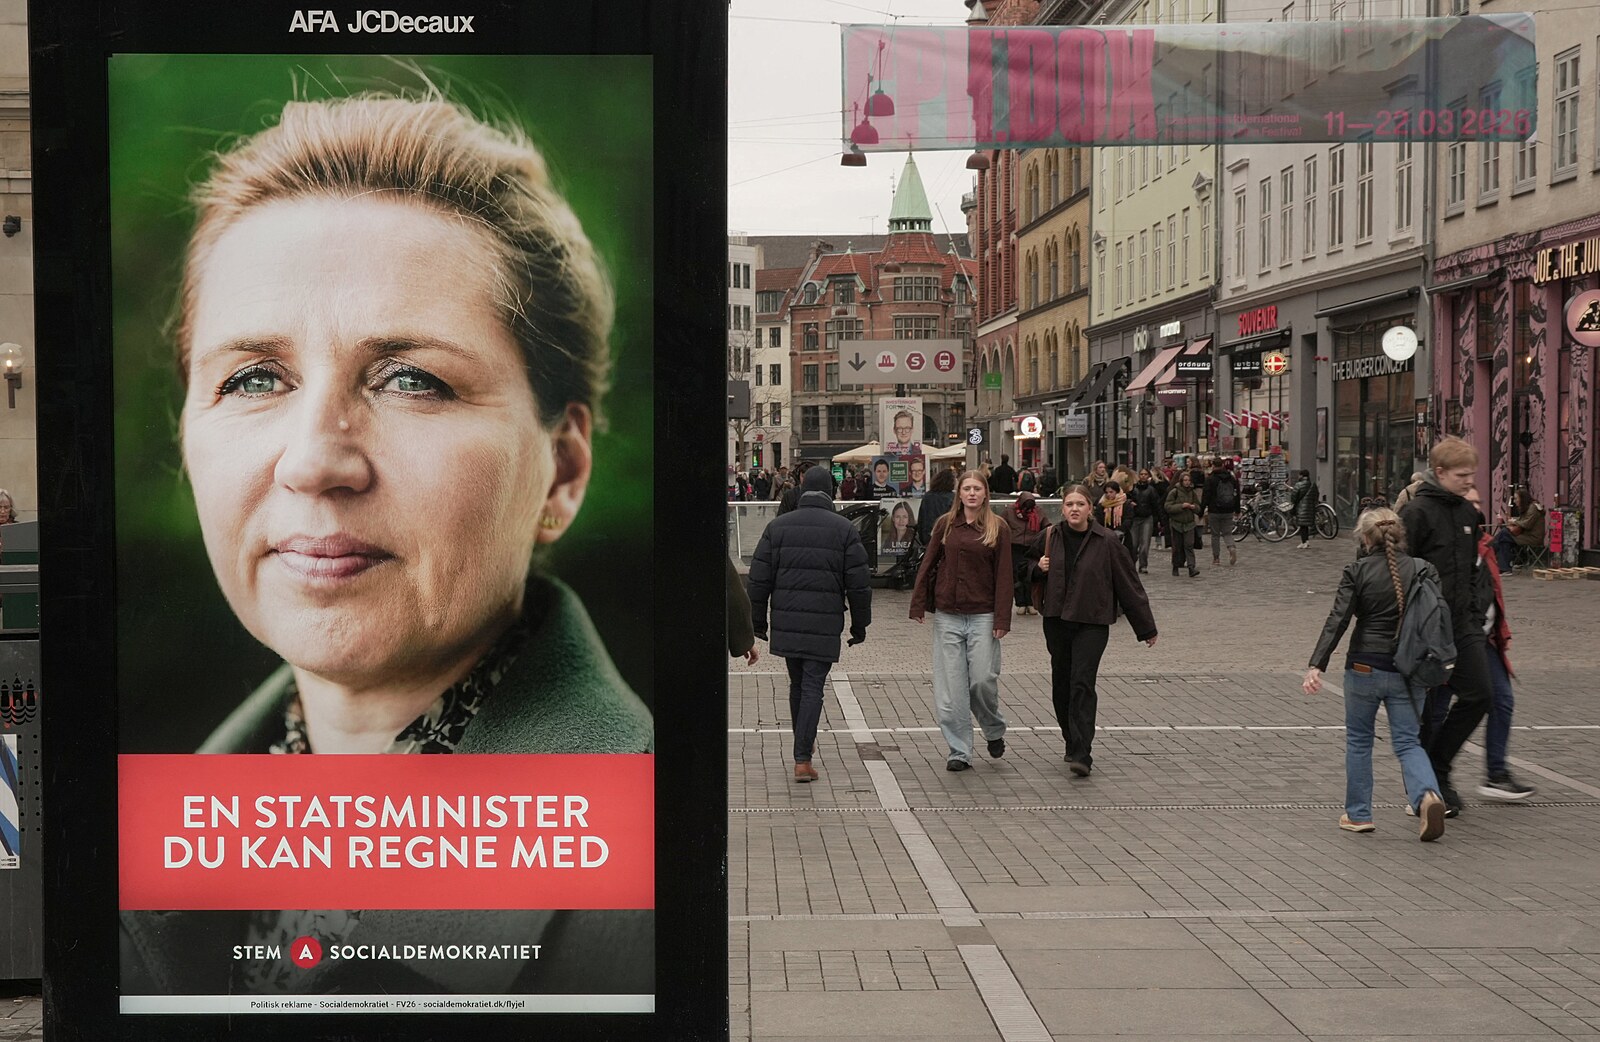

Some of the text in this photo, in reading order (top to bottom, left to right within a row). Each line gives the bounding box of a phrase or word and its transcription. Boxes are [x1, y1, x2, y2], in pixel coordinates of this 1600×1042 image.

[288, 10, 475, 33] AFA JCDecaux
[1533, 248, 1553, 284] JOE
[1552, 269, 1560, 280] &
[1559, 242, 1579, 279] THE
[1237, 305, 1278, 336] SOUVENIR
[1332, 362, 1346, 381] THE
[1345, 357, 1375, 380] BURGER
[969, 428, 982, 445] 3
[182, 794, 589, 829] EN STATSMINISTER
[163, 835, 609, 869] DU KAN REGNE MED
[232, 944, 542, 960] STEM A SOCIALDEMOKRATIET
[250, 1000, 279, 1009] Politisk
[281, 1000, 312, 1009] reklame
[319, 1000, 389, 1009] Socialdemokratiet
[396, 1000, 416, 1009] FV26
[423, 1000, 525, 1010] socialdemokratiet.dk/flyjel
